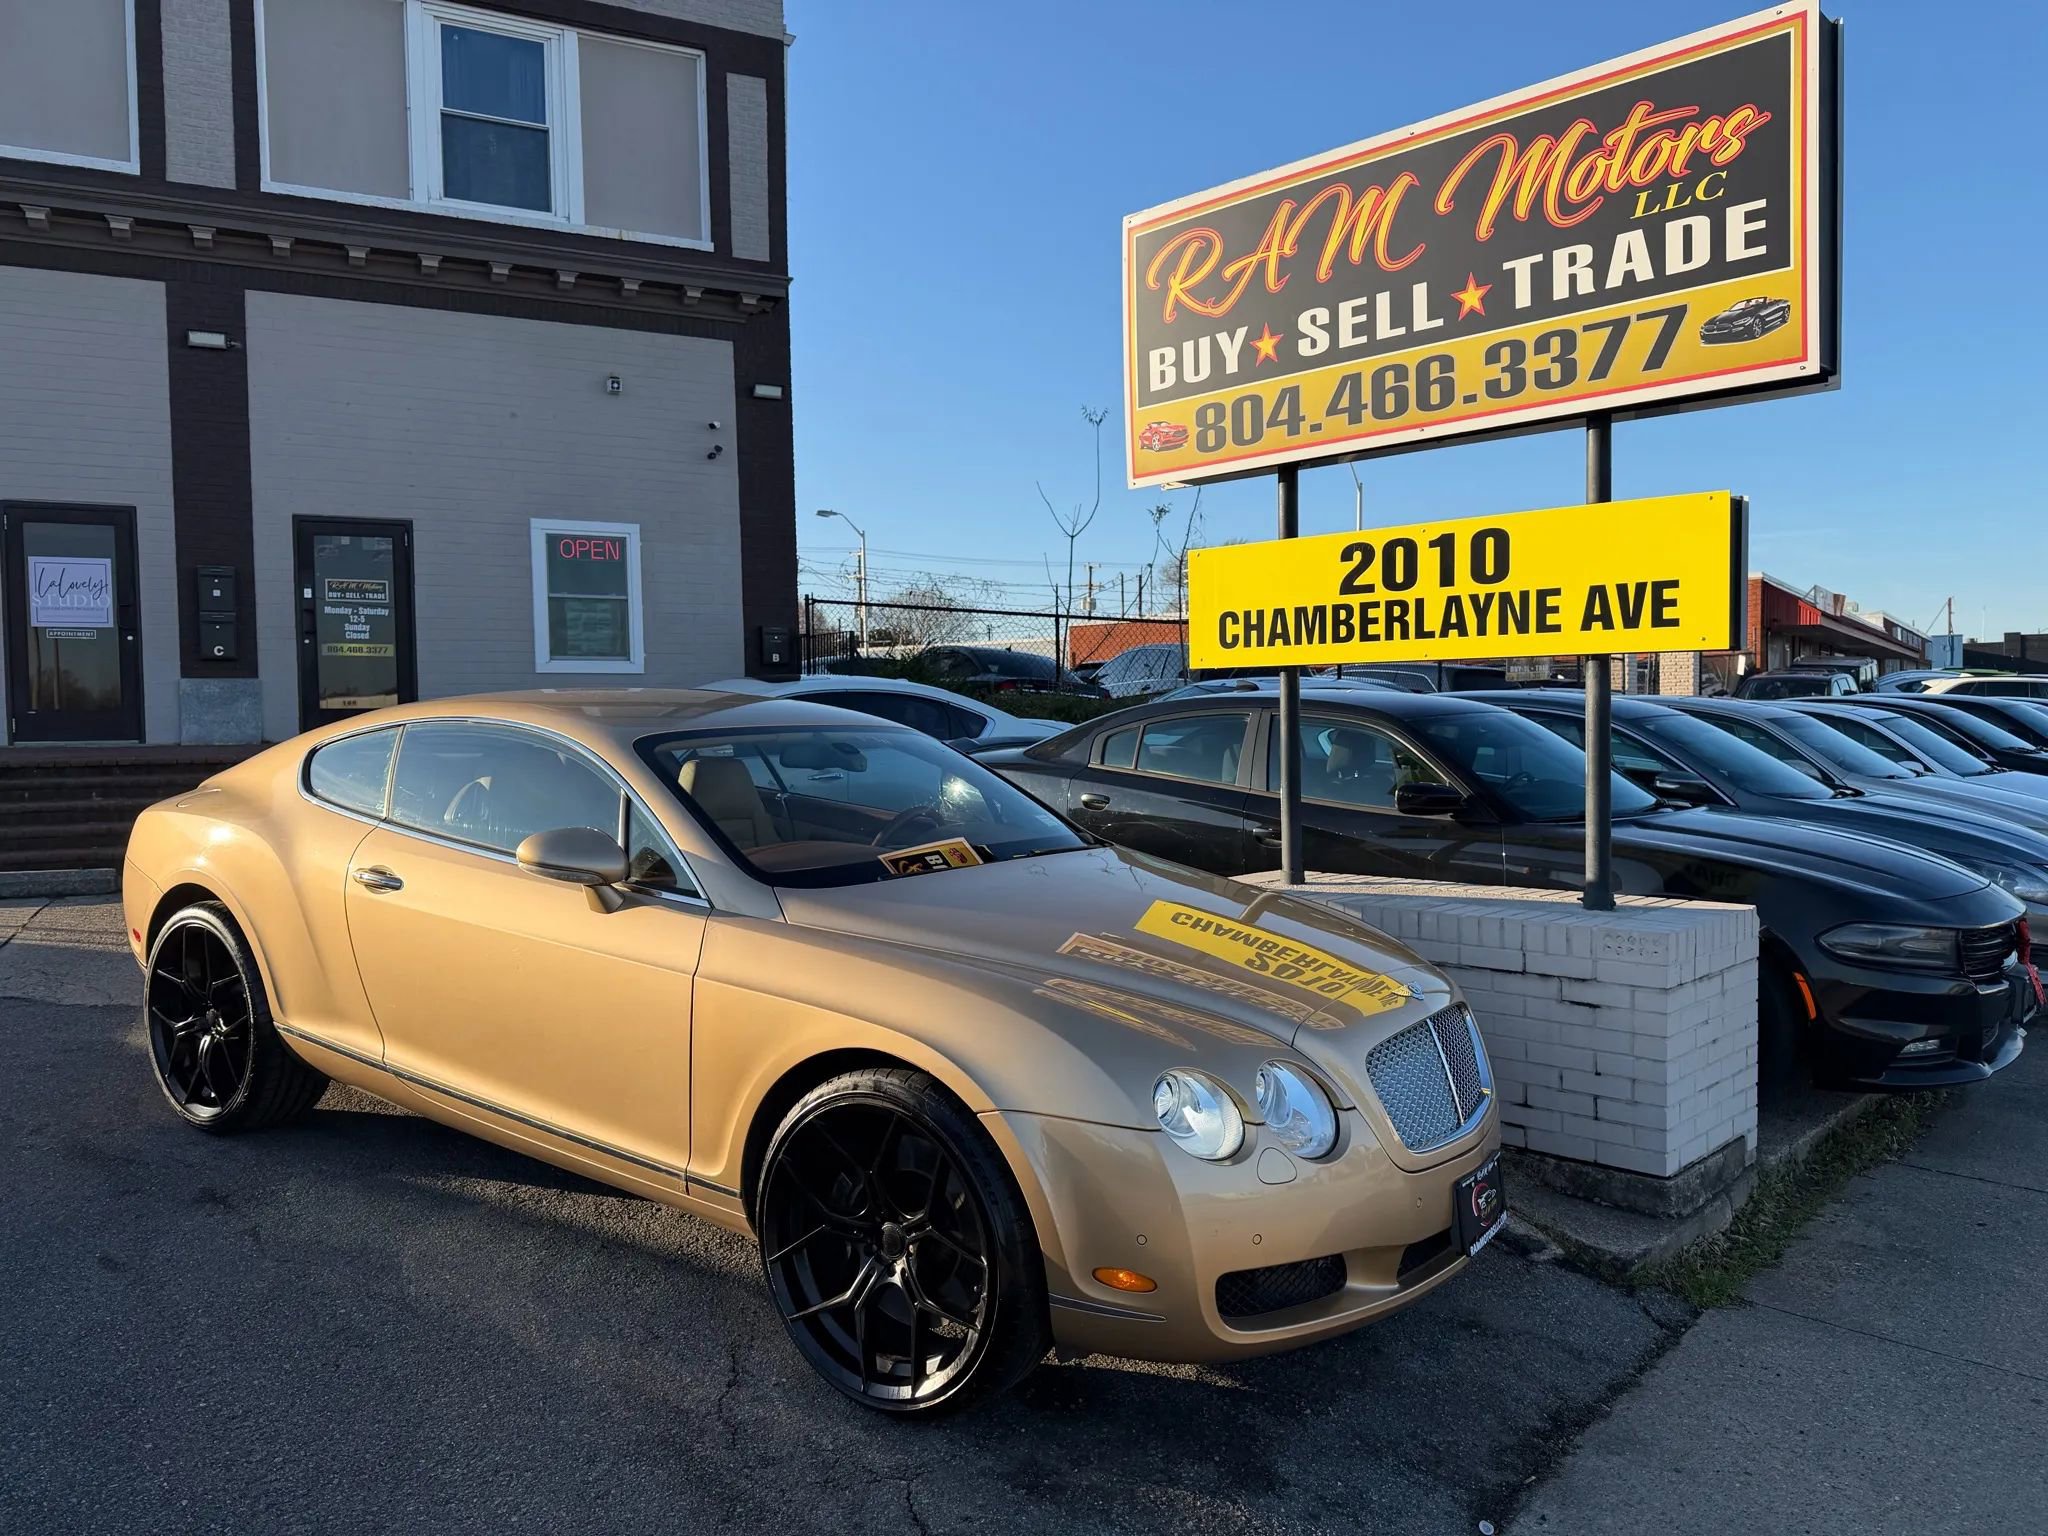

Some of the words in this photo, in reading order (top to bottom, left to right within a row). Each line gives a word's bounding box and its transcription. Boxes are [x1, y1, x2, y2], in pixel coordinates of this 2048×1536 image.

[1435, 101, 1773, 242] Motors
[1629, 170, 1729, 220] LLC
[1149, 326, 1249, 392] BUY
[1297, 281, 1444, 357] SELL
[1502, 198, 1767, 310] TRADE
[1195, 303, 1690, 454] 804.466.3377
[560, 539, 620, 560] OPEN
[1339, 527, 1511, 596] 2010
[324, 606, 352, 615] Monday
[358, 607, 389, 616] Saturday
[349, 615, 365, 623] 12-5
[1218, 587, 1562, 650] CHAMBERLAYNE
[1580, 579, 1681, 632] AVE
[344, 623, 370, 632] Sunday
[345, 631, 370, 639] Closed
[213, 645, 225, 656] C
[772, 653, 780, 663] B
